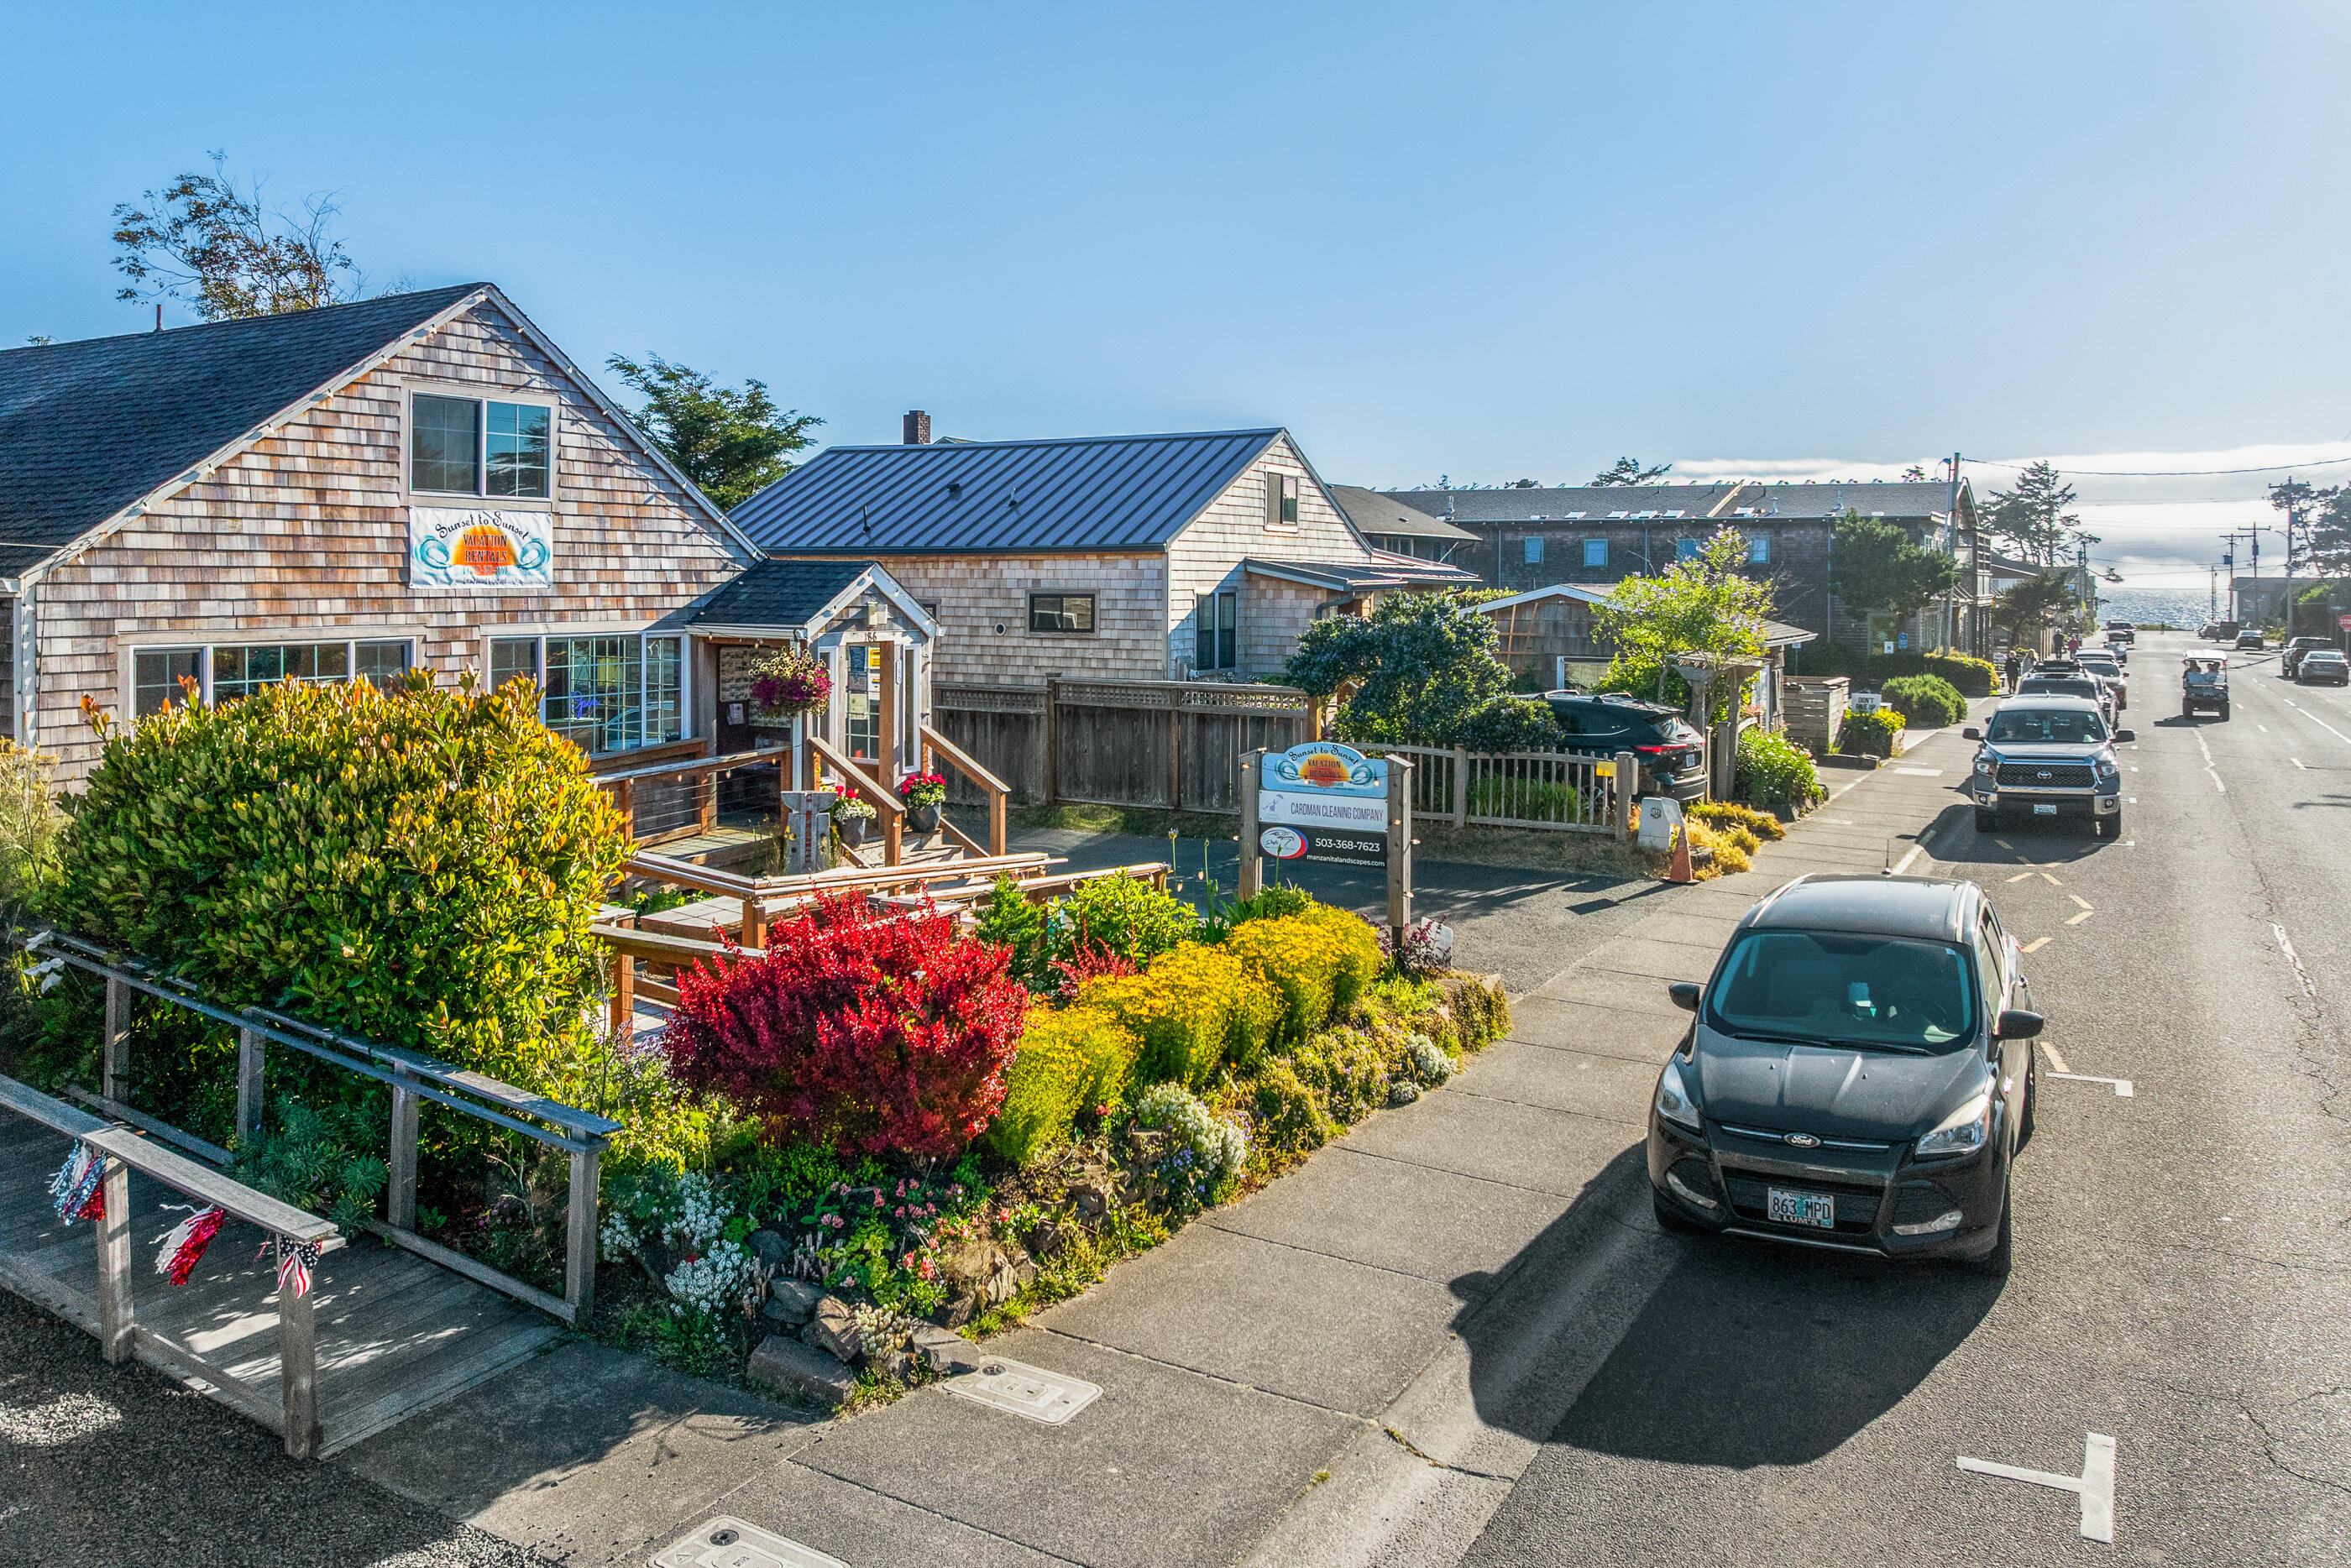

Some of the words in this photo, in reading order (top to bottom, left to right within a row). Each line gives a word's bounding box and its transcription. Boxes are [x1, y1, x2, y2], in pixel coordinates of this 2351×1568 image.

[436, 514, 474, 538] Sunset
[479, 514, 490, 525] to
[492, 510, 530, 541] Sunset
[463, 534, 508, 547] VACATION
[465, 550, 508, 563] RENTALS
[864, 631, 877, 643] 186
[568, 690, 600, 719] Open
[1289, 746, 1317, 761] Sunset
[1331, 745, 1359, 765] Sunset
[1307, 759, 1341, 769] VACATION
[1291, 802, 1321, 818] CARDMAN
[1322, 805, 1352, 819] CLEANING
[1353, 808, 1384, 822] COMPANY
[1315, 838, 1380, 852] 503-368-7623
[1306, 854, 1385, 867] manzanitalandscapes.com
[1791, 1135, 1812, 1146] Ford
[1772, 1196, 1797, 1215] 863
[1805, 1201, 1830, 1219] MPD
[1783, 1215, 1819, 1226] LUM'S
